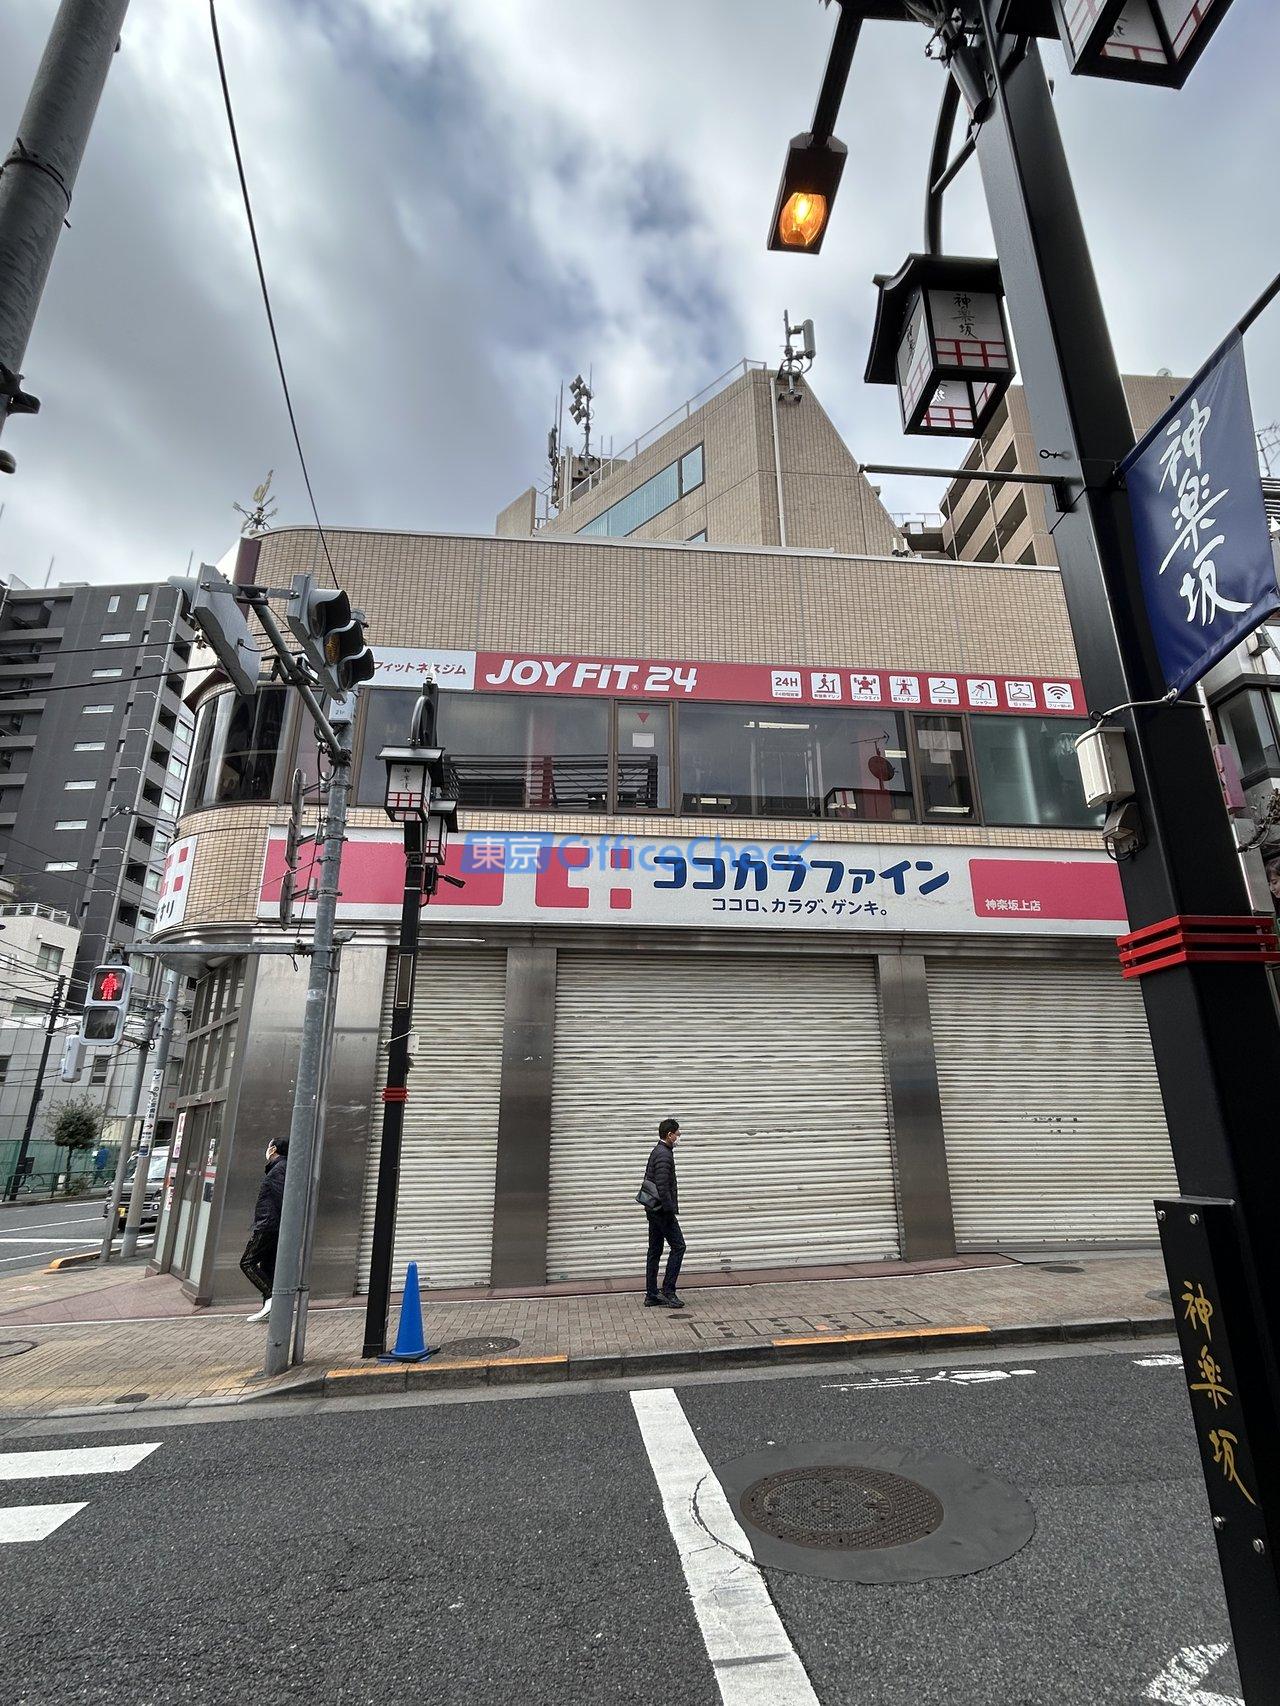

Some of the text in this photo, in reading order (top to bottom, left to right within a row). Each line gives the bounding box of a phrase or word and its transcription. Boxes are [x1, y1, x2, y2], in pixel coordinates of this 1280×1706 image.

[1158, 398, 1253, 626] 神楽坂
[775, 677, 798, 687] 24H
[653, 852, 950, 895] ココカラファイン
[712, 898, 887, 916] ココロ、カラダ、ゲンキ。
[984, 898, 1041, 912] 神楽坂上店
[1181, 1280, 1256, 1505] 神楽坂
